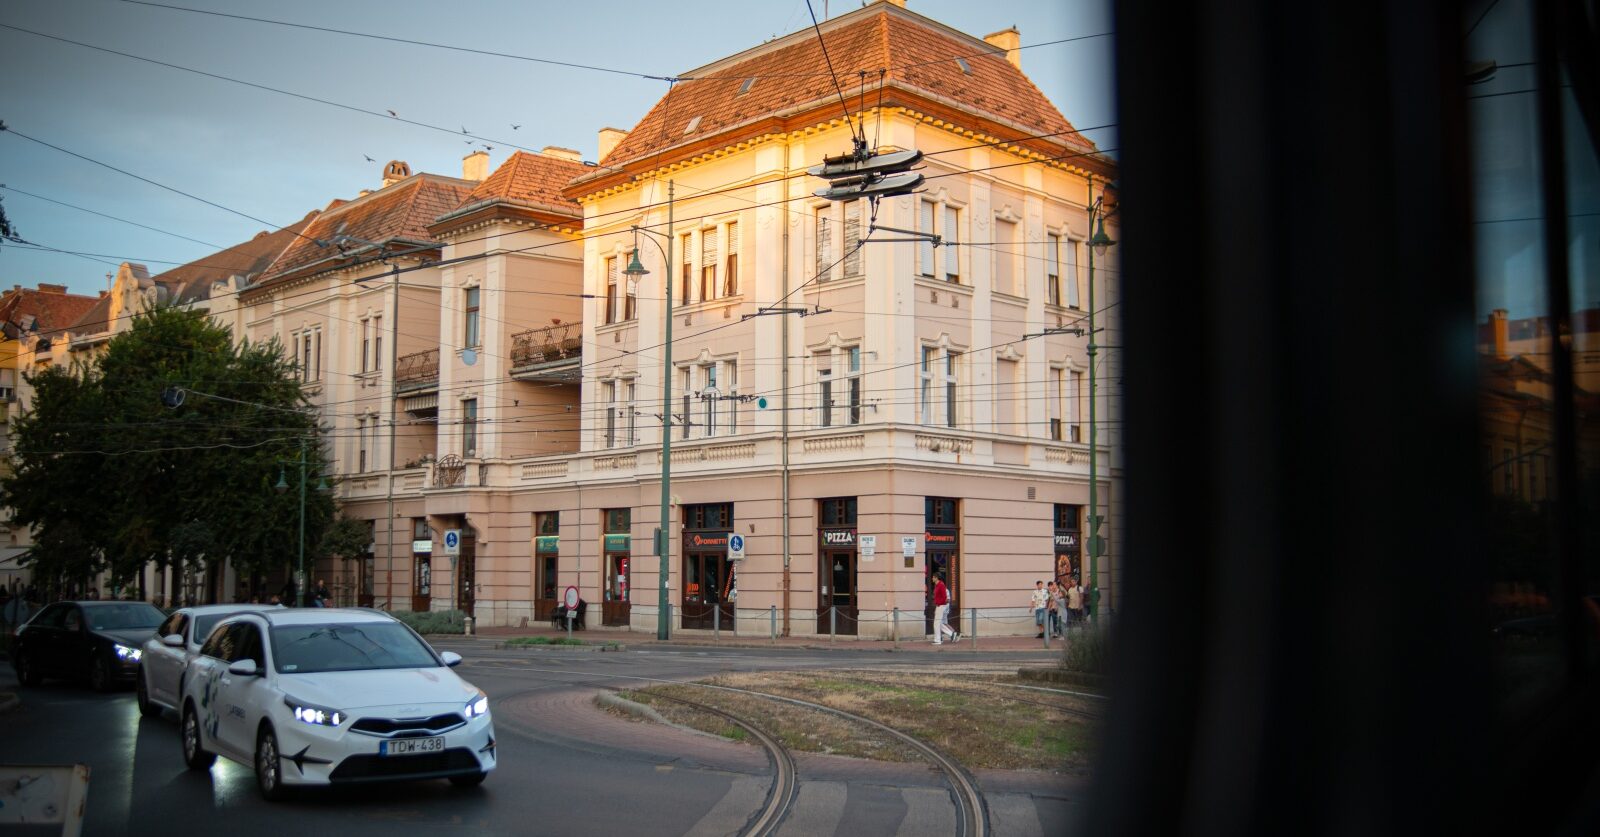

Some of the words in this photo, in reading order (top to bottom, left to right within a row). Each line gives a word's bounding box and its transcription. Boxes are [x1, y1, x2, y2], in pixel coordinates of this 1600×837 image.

[827, 532, 853, 543] PIZZA
[1055, 535, 1074, 545] PIZZA
[389, 738, 442, 753] TDW-438
